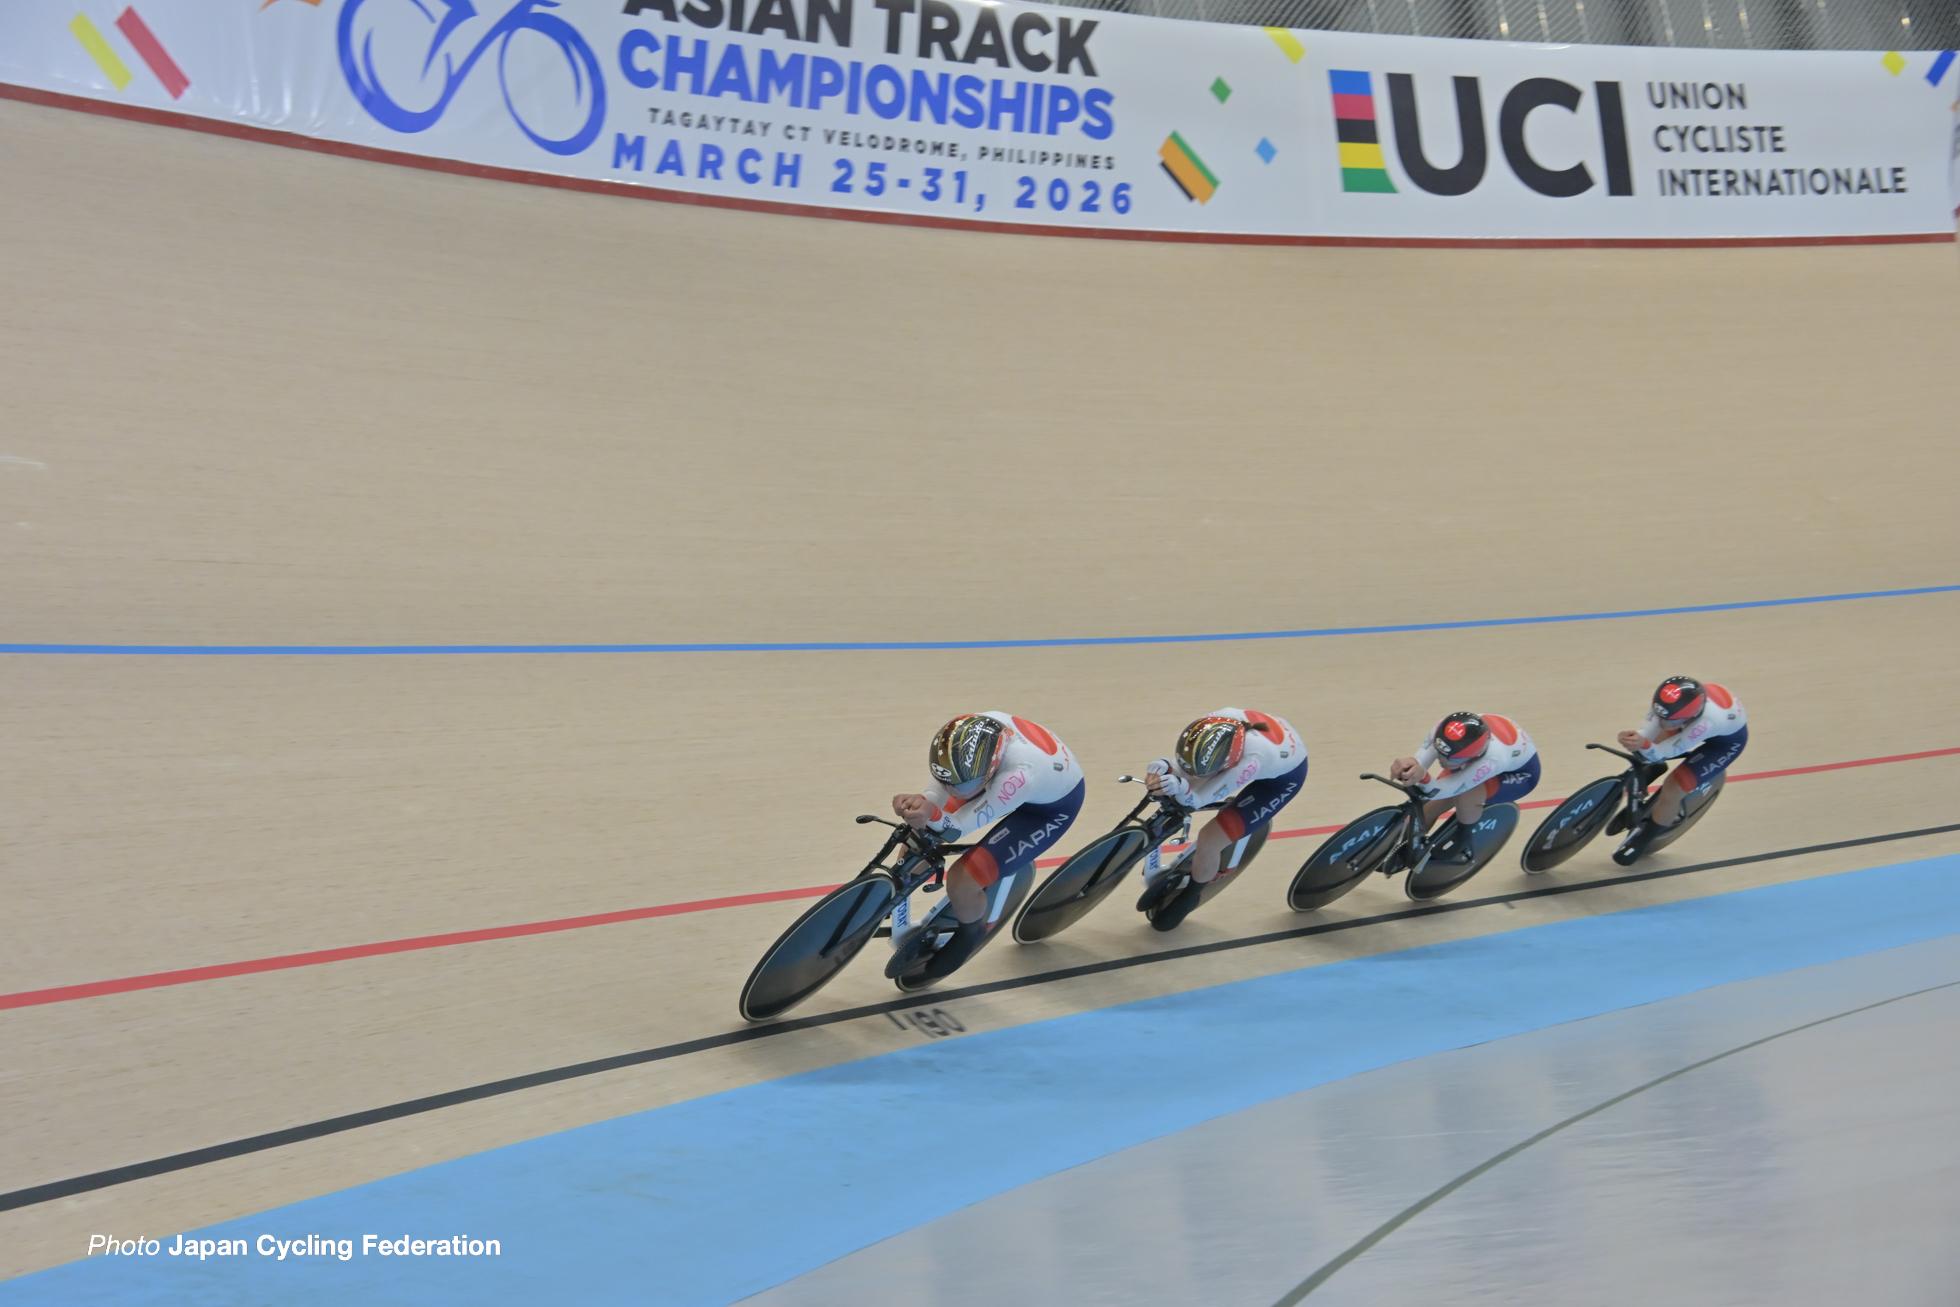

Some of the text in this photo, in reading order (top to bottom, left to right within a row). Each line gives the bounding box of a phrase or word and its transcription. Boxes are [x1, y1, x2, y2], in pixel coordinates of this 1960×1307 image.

[875, 0, 1100, 77] TRACK
[618, 28, 1115, 141] CHAMPIONSHIPS
[1645, 81, 1747, 110] UNION
[649, 107, 1117, 170] TAGAYTAY CT VELODROME, PHILIPPINES
[1385, 72, 1636, 198] UCI
[1652, 125, 1787, 154] CYCLISTE
[612, 132, 1133, 215] MARCH 25-31, 2026
[1657, 166, 1909, 198] INTERNATIONALE
[1701, 743, 1741, 777] JAPAN
[1250, 782, 1297, 824] JAPAN
[1004, 813, 1069, 864] JAPAN
